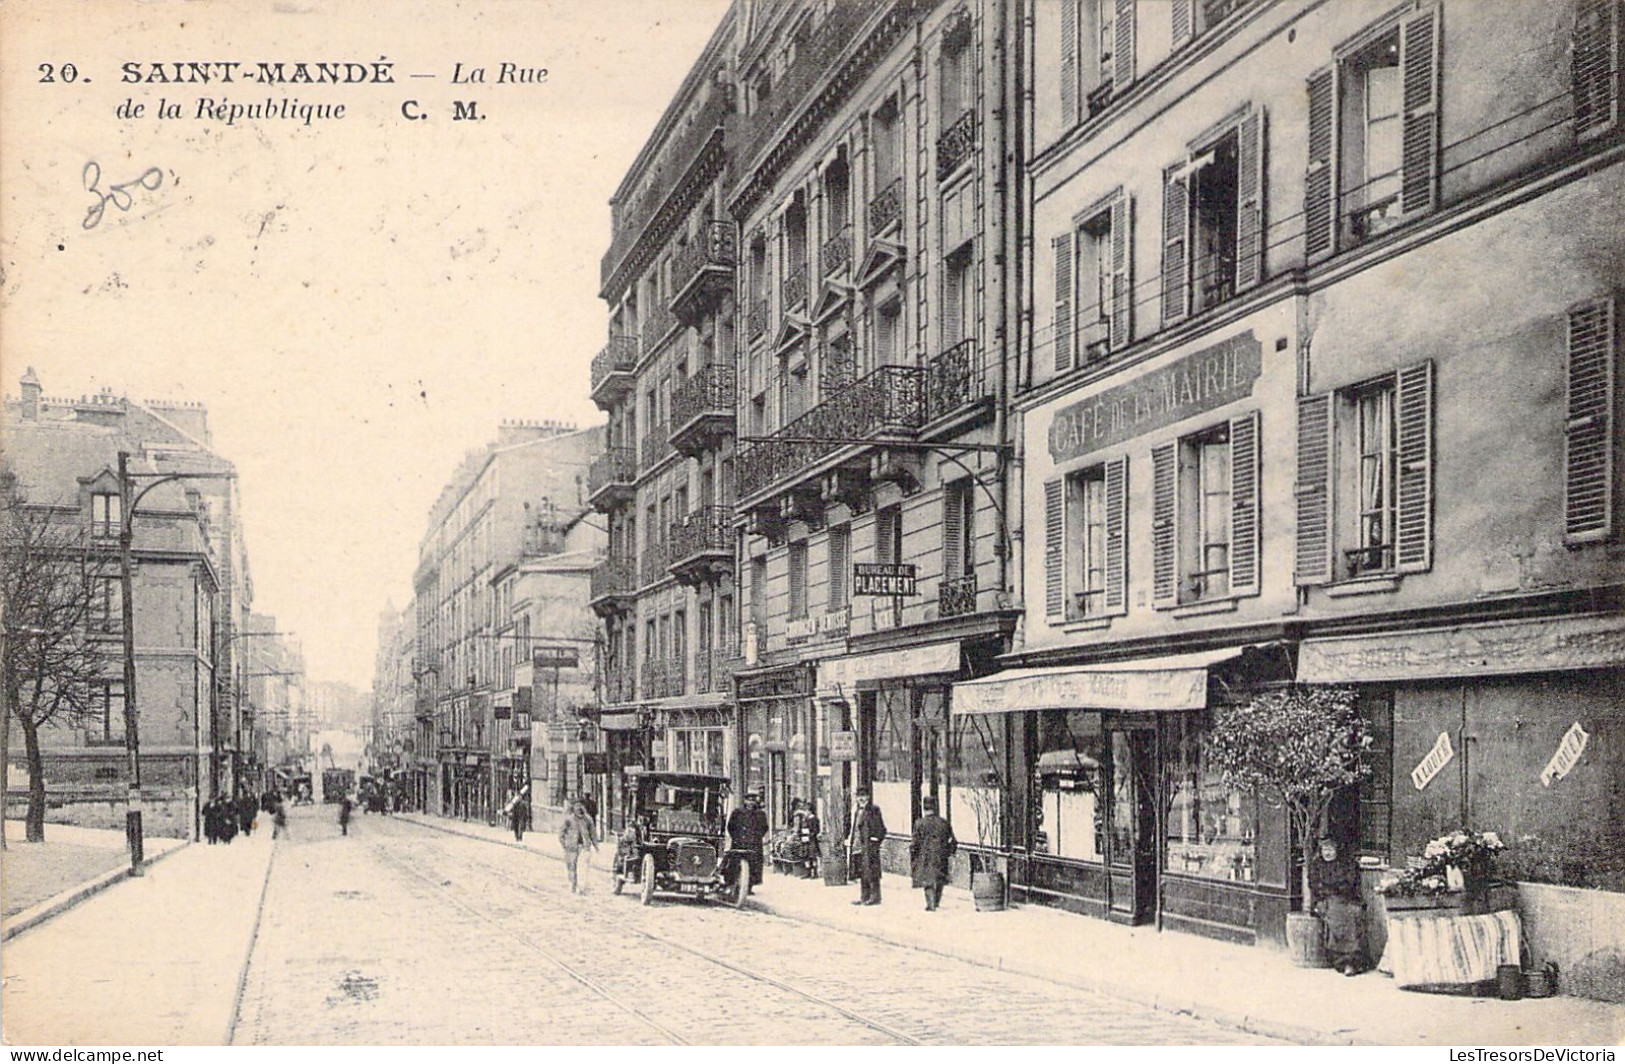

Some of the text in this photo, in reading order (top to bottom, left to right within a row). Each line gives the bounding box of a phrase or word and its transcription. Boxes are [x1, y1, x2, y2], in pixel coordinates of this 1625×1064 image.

[1111, 398, 1127, 433] DE
[1134, 394, 1152, 424] LA
[1160, 346, 1248, 414] MAIRIE
[858, 564, 910, 576] BUREAU DE
[854, 576, 915, 594] PLACEMENT
[1421, 739, 1450, 779] LOUER
